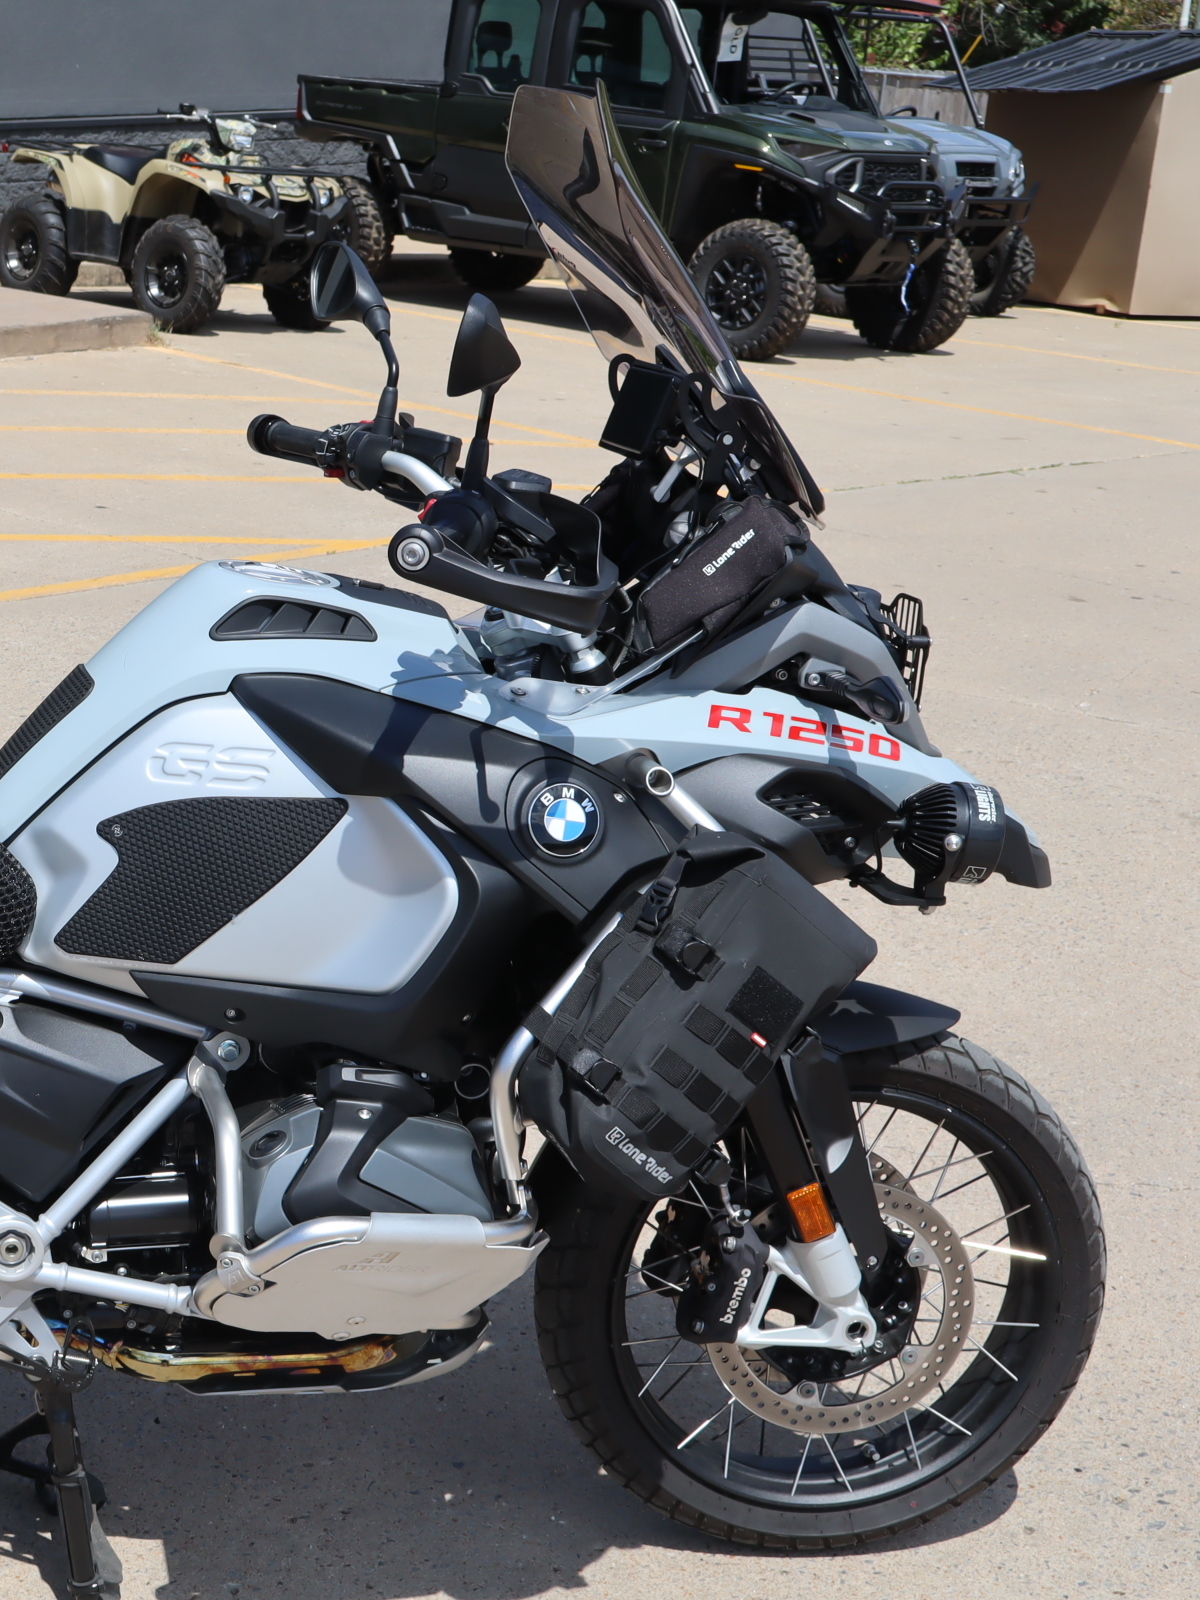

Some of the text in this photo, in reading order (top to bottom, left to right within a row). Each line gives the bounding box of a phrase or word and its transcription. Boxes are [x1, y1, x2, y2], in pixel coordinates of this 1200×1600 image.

[730, 27, 743, 54] OLD
[707, 704, 901, 762] R 1250
[145, 741, 277, 790] GS
[540, 786, 595, 813] BMW
[974, 789, 992, 822] LIGHTS
[719, 1267, 752, 1325] brembo
